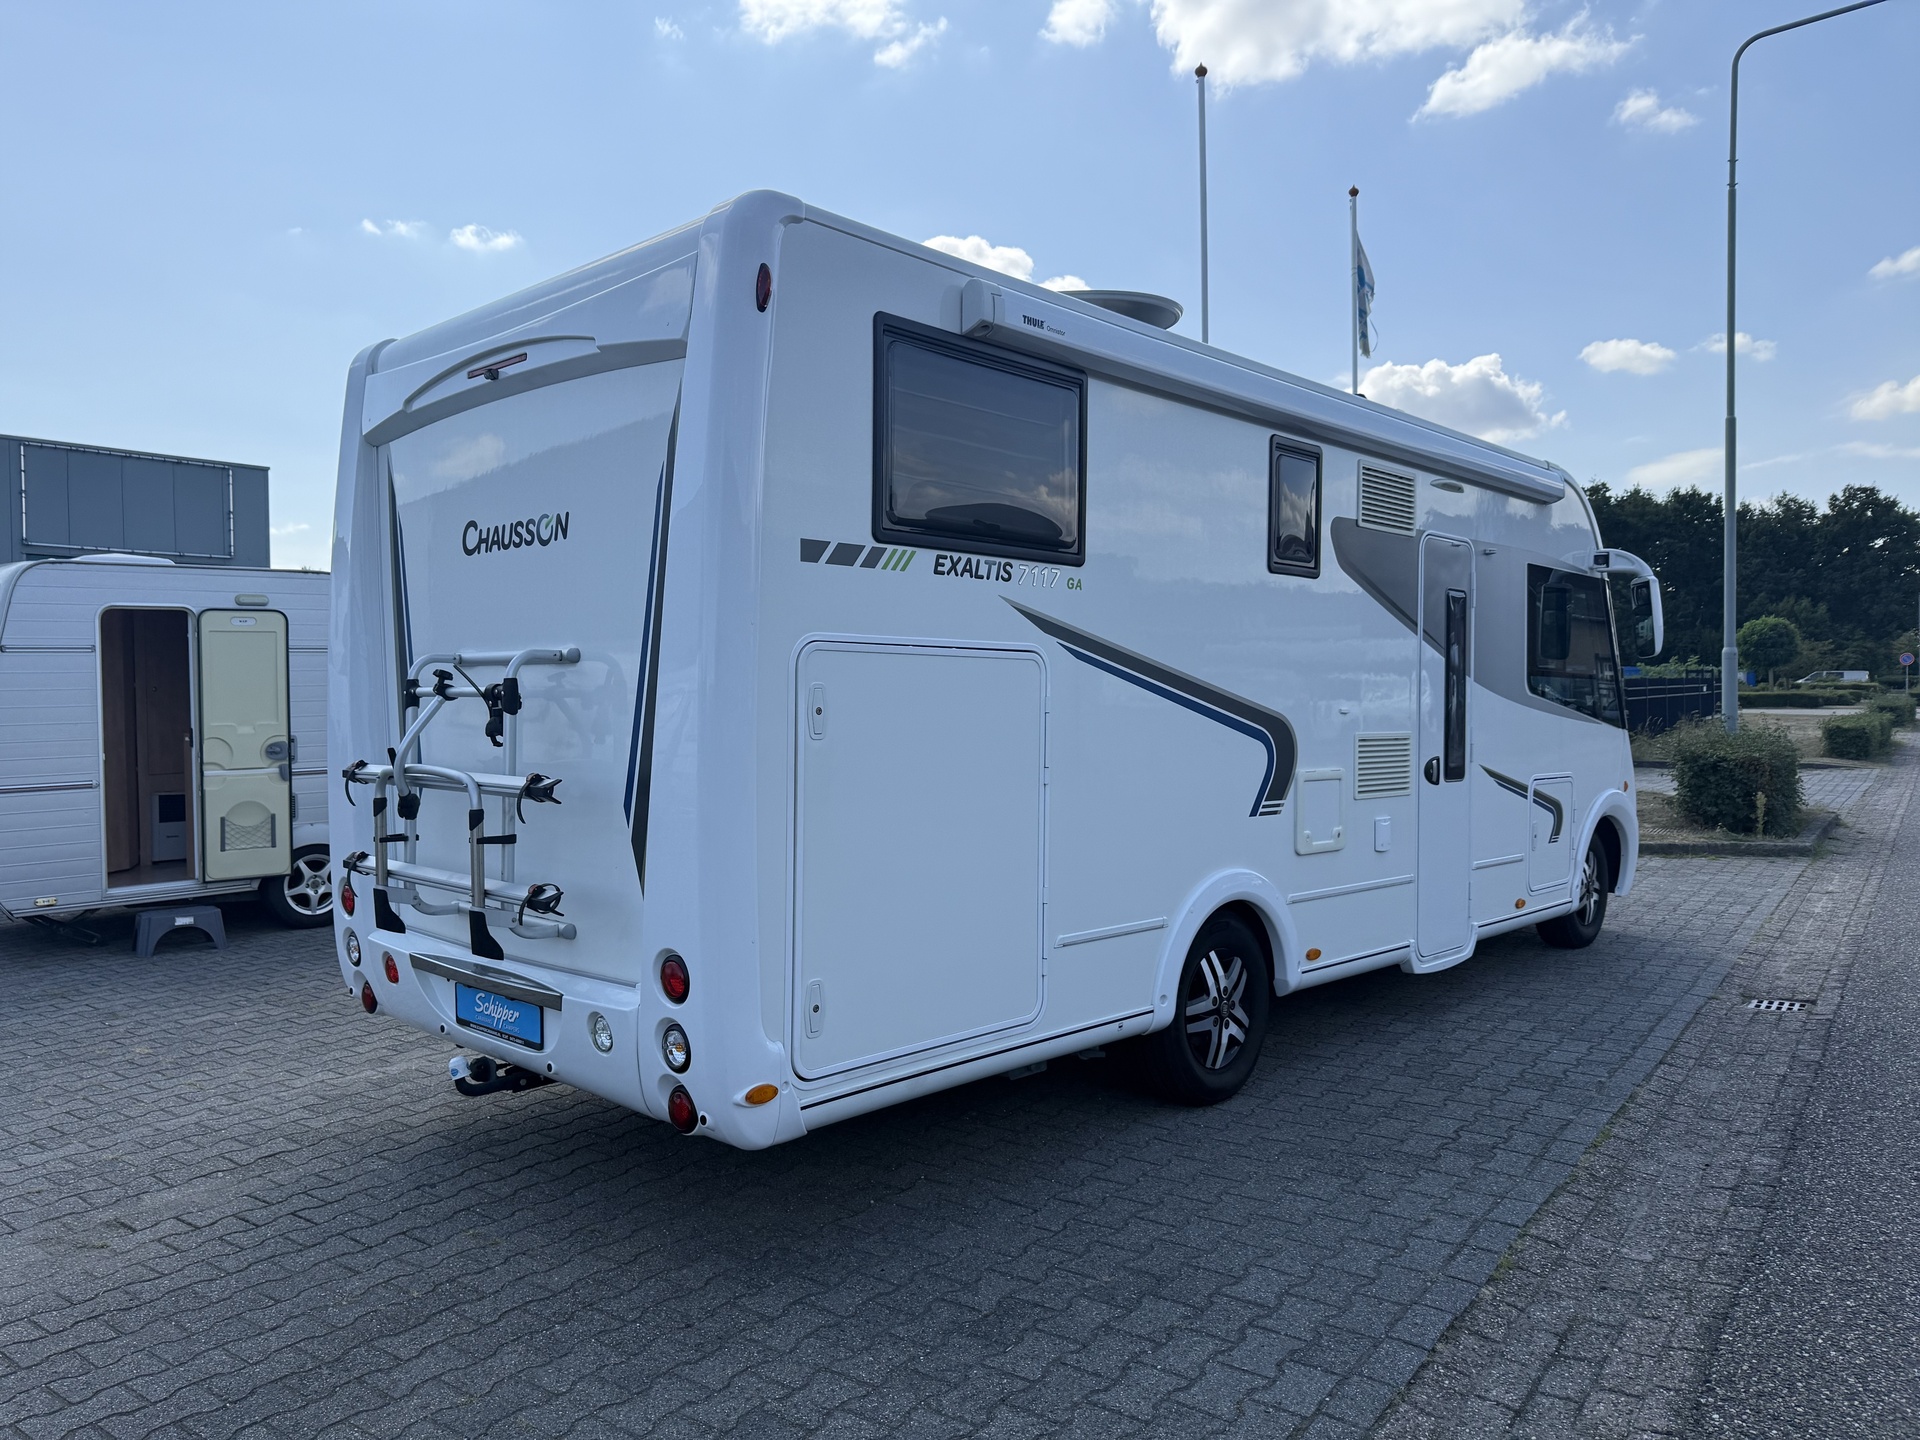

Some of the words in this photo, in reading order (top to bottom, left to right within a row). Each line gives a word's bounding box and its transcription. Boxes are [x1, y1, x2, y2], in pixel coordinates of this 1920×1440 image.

[1022, 314, 1045, 329] THULE
[933, 553, 1014, 583] EXALTIS
[1017, 564, 1061, 589] 7117
[1066, 577, 1083, 591] GA
[474, 992, 520, 1029] Schipper
